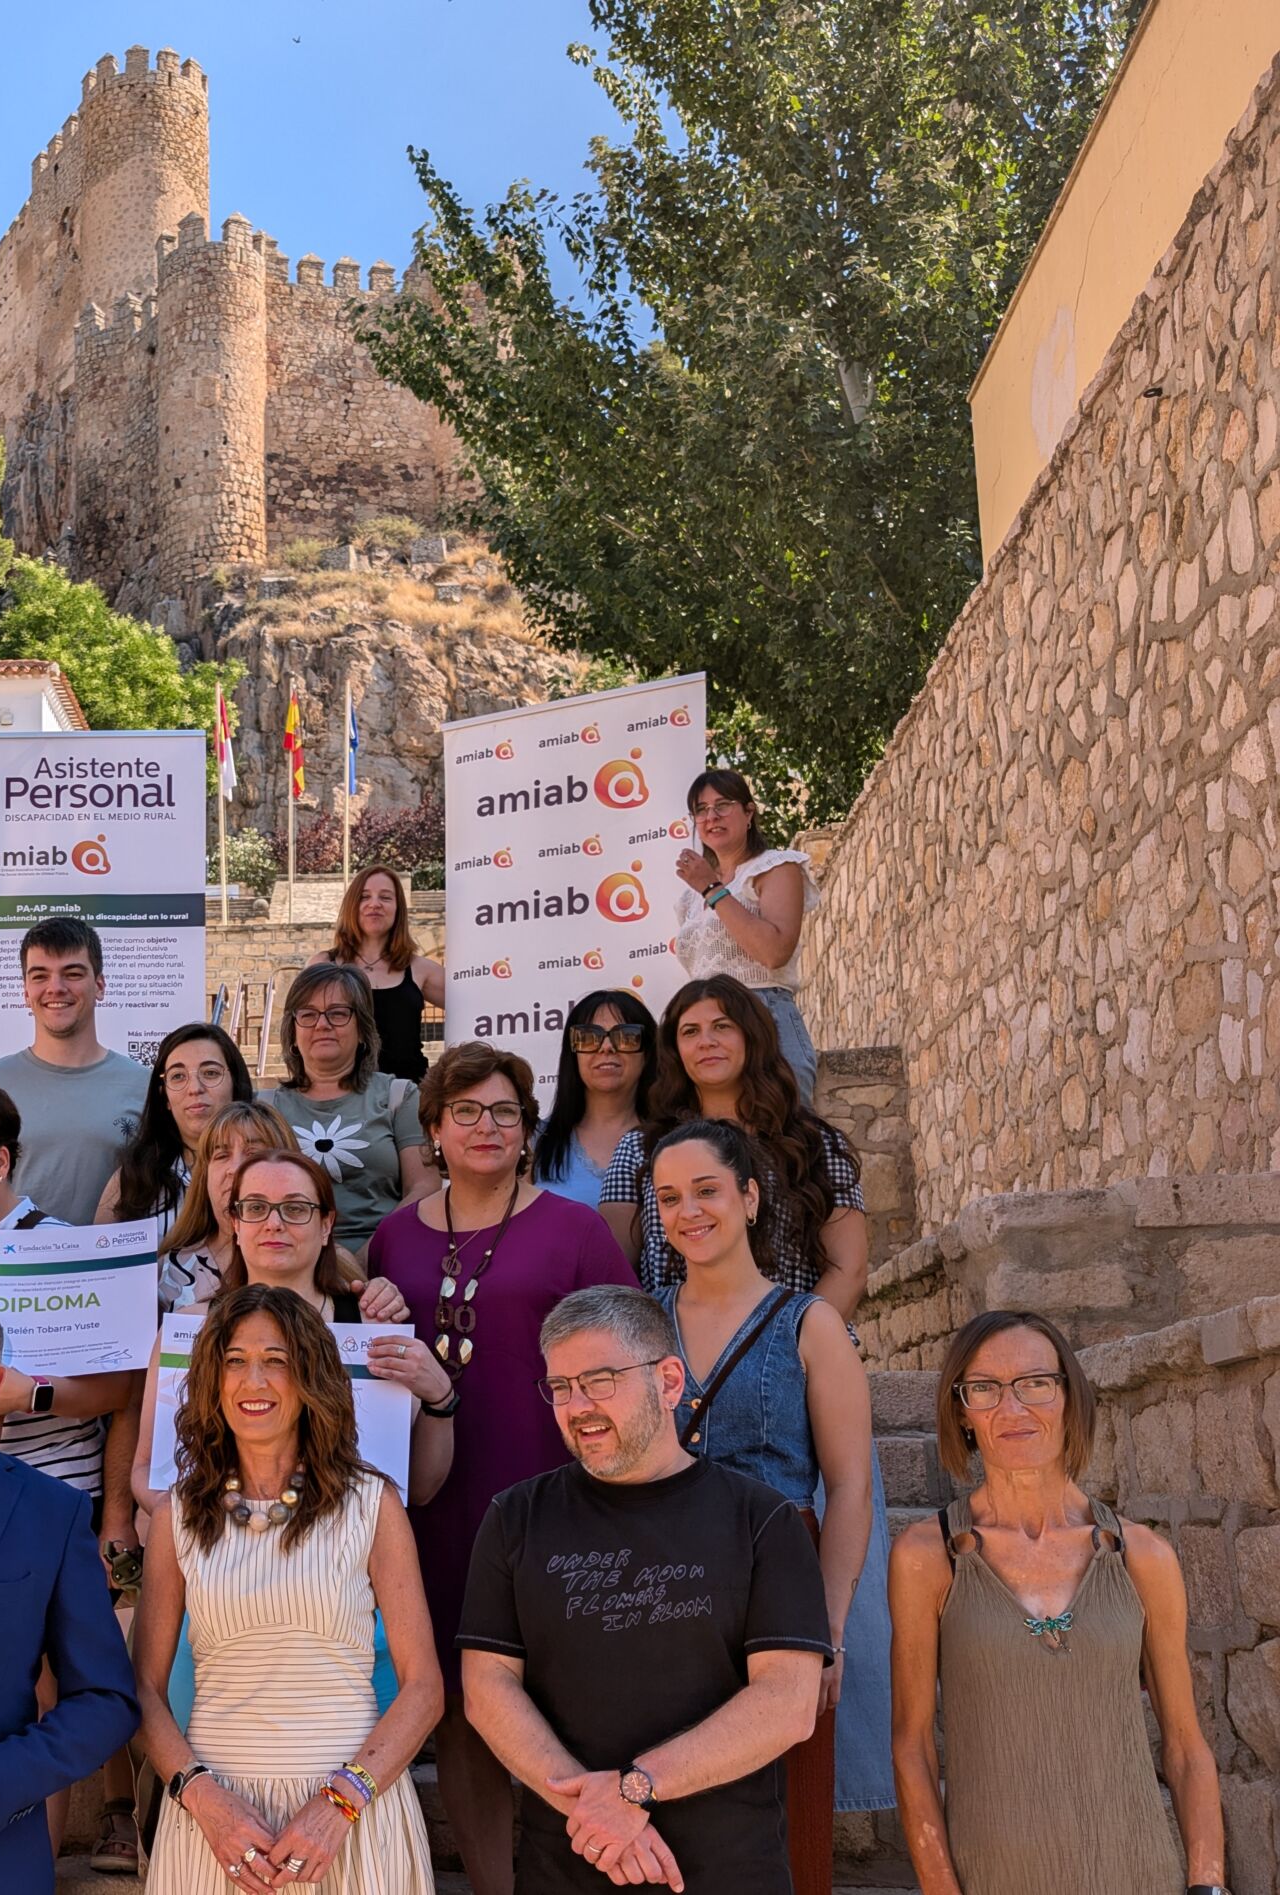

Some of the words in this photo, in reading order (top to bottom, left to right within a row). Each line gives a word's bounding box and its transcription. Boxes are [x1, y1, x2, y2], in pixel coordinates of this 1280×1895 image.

[627, 715, 668, 733] amiab
[538, 731, 580, 749] amiab
[455, 748, 494, 765] amiab
[34, 756, 160, 779] Asistente
[5, 773, 175, 809] Personal
[476, 775, 588, 818] amiab
[5, 813, 74, 822] DISCAPACIDAD
[77, 813, 90, 821] EN
[108, 812, 140, 820] MEDIO
[144, 812, 176, 820] RURAL
[628, 827, 667, 845] amiab
[538, 842, 580, 858] amiab
[454, 855, 492, 872] amiab
[16, 904, 47, 913] PA-AP
[50, 904, 81, 912] amiab
[475, 886, 589, 926] amiab
[95, 913, 147, 921] discapacidad
[628, 941, 668, 959] amiab
[538, 954, 581, 970] amiab
[452, 964, 491, 980] amiab
[474, 1002, 575, 1037] amia
[112, 1233, 147, 1245] Personal
[7, 1326, 34, 1335] Belén
[37, 1325, 72, 1333] Tobarra
[74, 1321, 100, 1331] Yuste
[173, 1331, 197, 1339] amia
[546, 1549, 632, 1574] UNDER
[561, 1569, 622, 1593] THE
[633, 1564, 705, 1588] MOON
[566, 1584, 667, 1620] FLOWERS
[602, 1610, 642, 1632] IN
[649, 1594, 712, 1625] BLOOM
